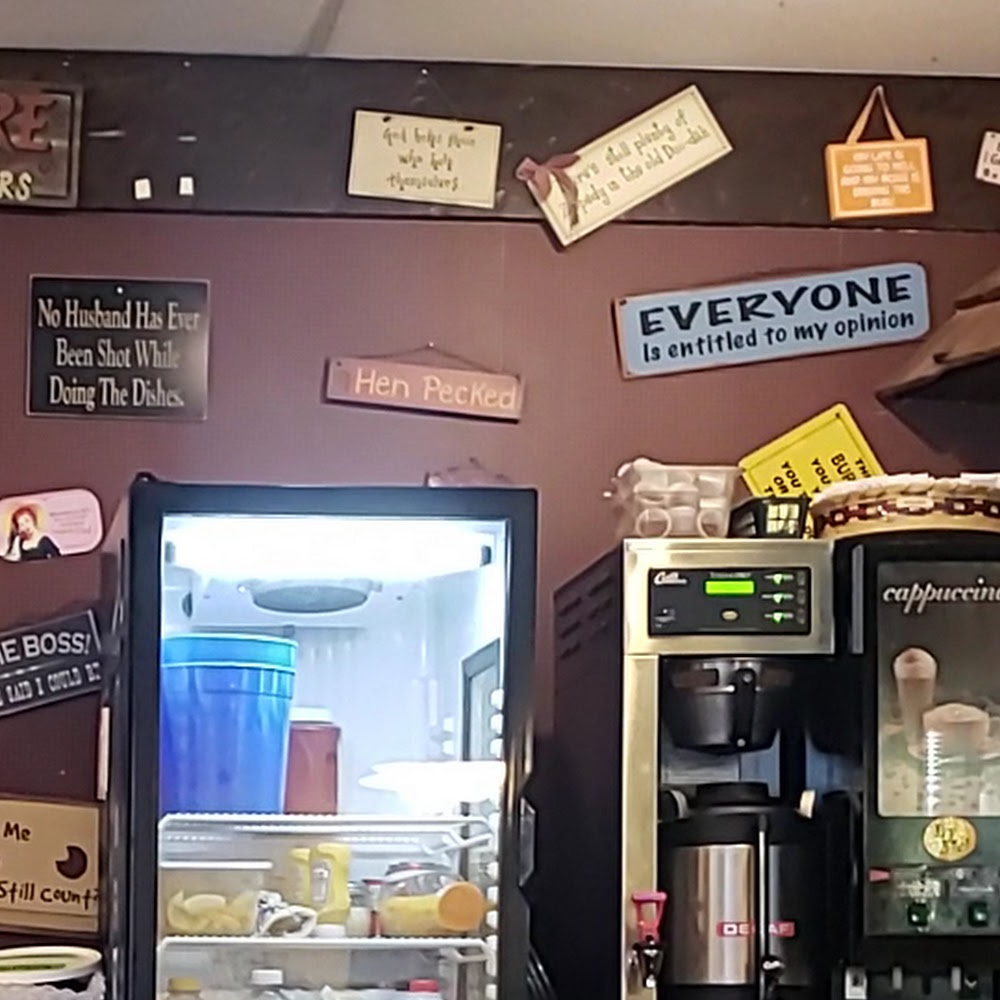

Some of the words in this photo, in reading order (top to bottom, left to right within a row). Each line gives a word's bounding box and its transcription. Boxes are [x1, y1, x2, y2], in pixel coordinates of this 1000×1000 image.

[38, 298, 62, 328] No
[65, 298, 132, 329] Husband
[135, 300, 163, 330] Has
[168, 302, 200, 331] Ever
[638, 274, 913, 337] EVERYONE
[668, 324, 759, 359] entitled
[766, 326, 788, 346] to
[794, 319, 829, 342] my
[834, 310, 915, 340] opinion
[56, 337, 94, 367] Been
[97, 338, 132, 369] Shot
[134, 340, 181, 369] While
[50, 374, 96, 412] Doing
[98, 376, 129, 407] The
[354, 368, 410, 399] Hen
[423, 374, 517, 410] Pecked
[773, 476, 790, 495] OR
[780, 461, 802, 489] YOU
[811, 458, 832, 485] YOU
[22, 632, 91, 658] BOSS!
[2, 821, 32, 842] Me
[723, 923, 795, 936] DEAF
